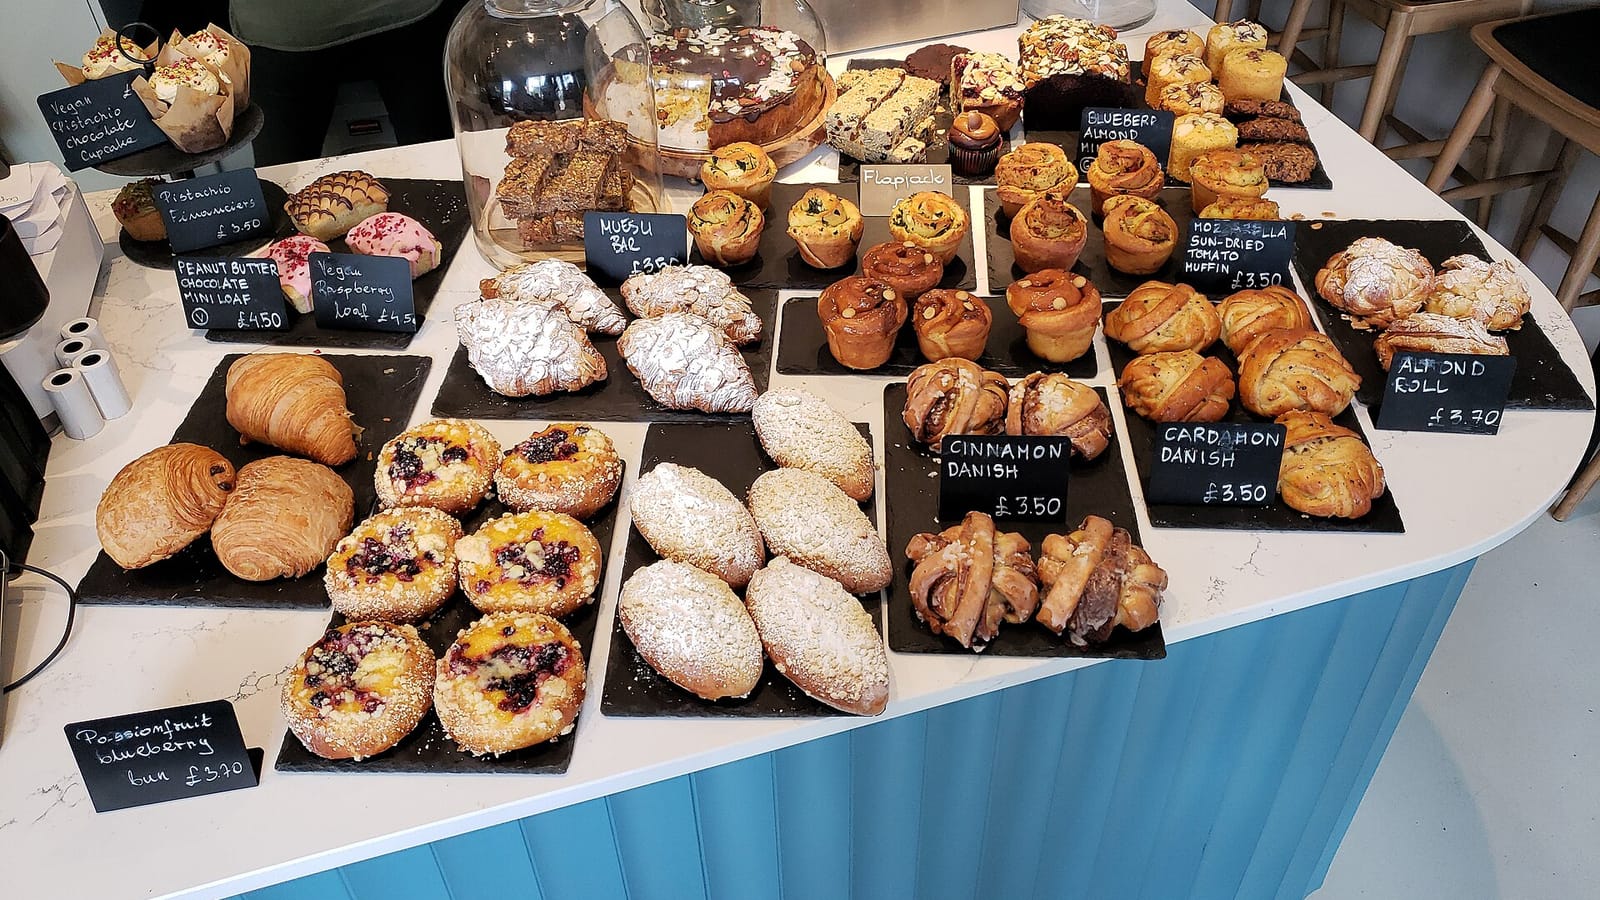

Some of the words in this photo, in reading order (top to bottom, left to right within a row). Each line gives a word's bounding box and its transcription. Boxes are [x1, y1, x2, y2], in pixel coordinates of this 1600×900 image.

[50, 97, 92, 115] Vegan
[52, 107, 121, 132] Pistachio
[1083, 126, 1138, 140] ALMOND
[81, 136, 137, 161] Cupcake
[863, 168, 944, 190] Flapjack
[159, 184, 231, 203] Pistachio
[169, 198, 256, 223] Financiers
[610, 235, 640, 254] BAR
[1190, 235, 1265, 251] SUN-DRIED
[1187, 249, 1239, 261] TOMATO
[177, 260, 227, 275] PEANUT
[231, 261, 279, 276] BUTTER
[317, 260, 362, 281] Vegan
[1185, 262, 1230, 274] MUFFIN
[180, 277, 249, 289] CHOCOLATE
[1231, 270, 1282, 289] £3.50
[183, 291, 214, 304] MINI
[218, 293, 251, 305] LOAF
[314, 280, 395, 303] Raspberry
[237, 311, 281, 328] £4.50
[1395, 377, 1449, 394] ROLL
[950, 440, 1062, 460] CINNAMON
[1161, 447, 1235, 468] DANISH
[948, 462, 1018, 479] DANISH
[1203, 482, 1267, 503] £3.50
[995, 496, 1061, 517] £3.50
[75, 713, 213, 745] Passionfruit
[96, 738, 214, 765] blueberry
[128, 770, 170, 786] bun
[185, 761, 243, 787] £3.70
